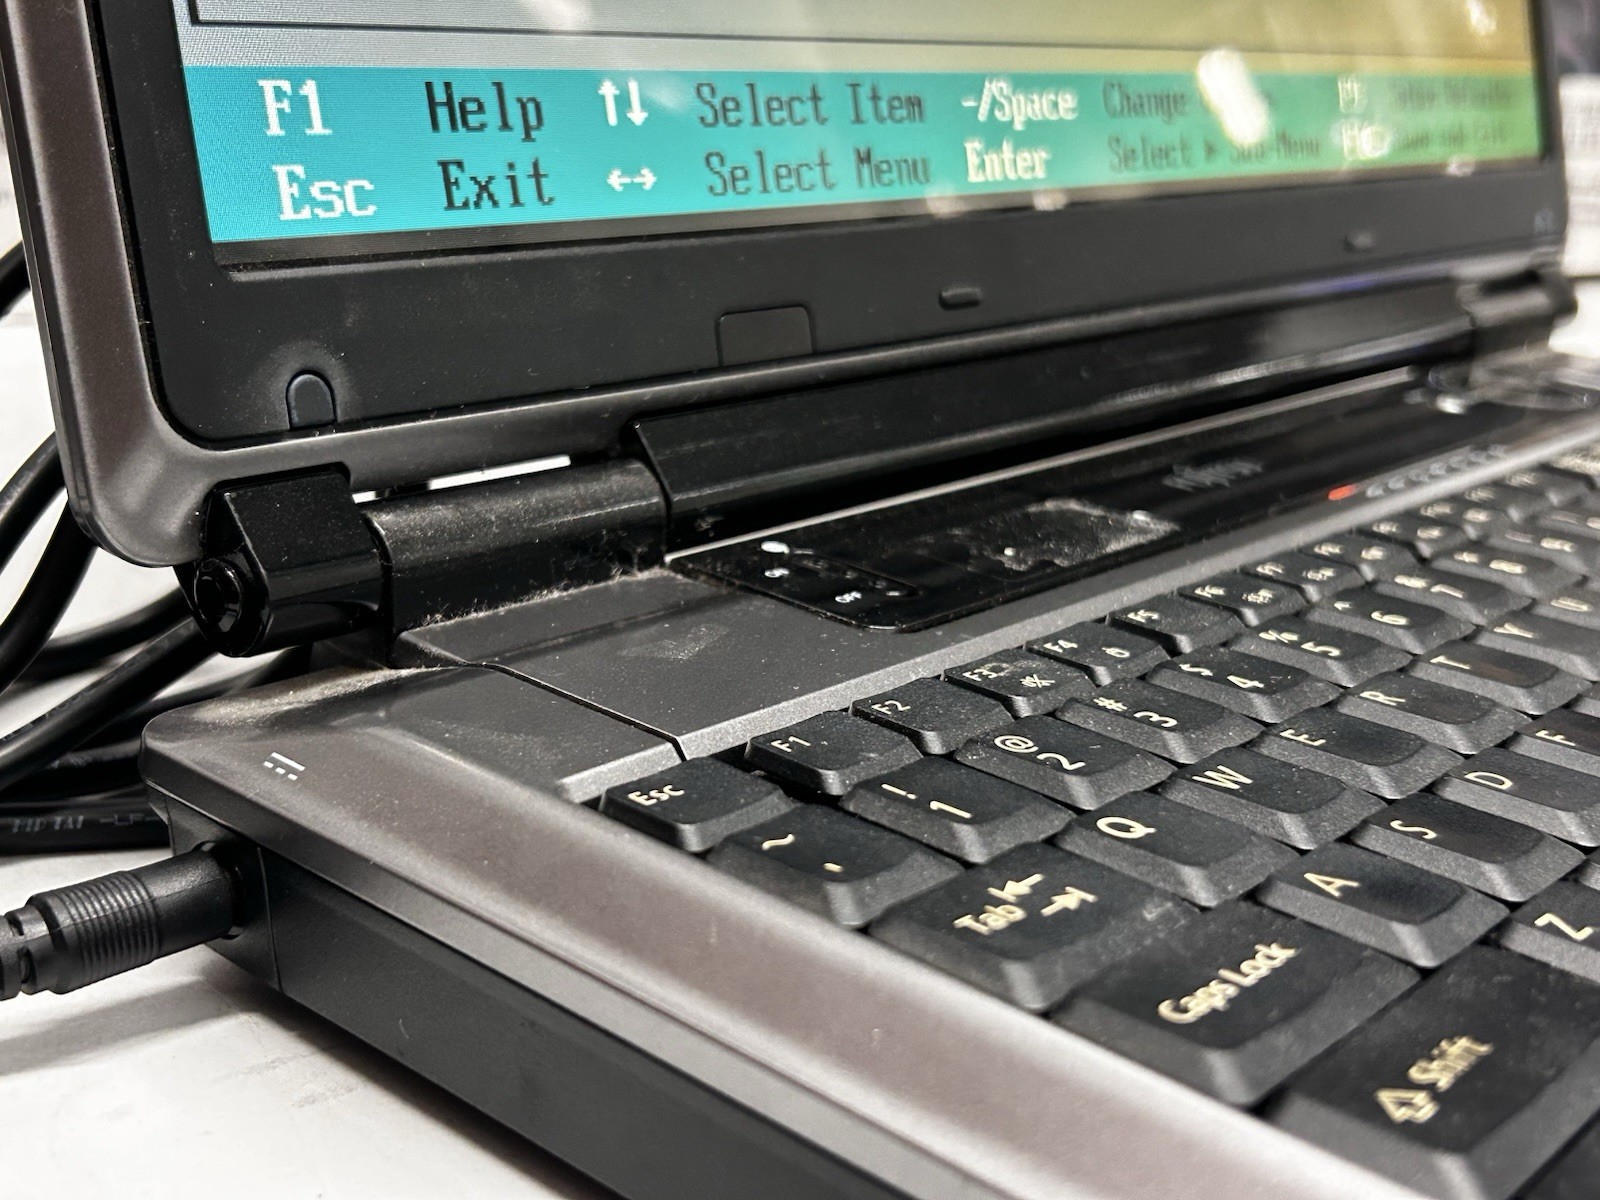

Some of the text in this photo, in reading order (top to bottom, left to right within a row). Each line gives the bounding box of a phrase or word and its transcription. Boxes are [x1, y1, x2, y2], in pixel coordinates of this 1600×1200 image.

[257, 78, 332, 136] F1
[424, 81, 544, 142] Help
[695, 82, 828, 128] Select
[846, 82, 924, 125] Item
[1103, 82, 1189, 126] Change
[272, 164, 376, 221] Esc
[437, 157, 555, 211] Exit
[704, 147, 836, 196] Select
[853, 145, 932, 188] Menu
[963, 138, 1050, 183] Enter
[1108, 134, 1193, 174] Select
[1127, 610, 1159, 624] F5
[1371, 610, 1410, 625] 6
[1494, 622, 1535, 640] Y
[1044, 639, 1078, 654] F4
[1301, 641, 1341, 657] 5
[1430, 655, 1471, 669] T
[962, 666, 998, 682] F3
[1227, 674, 1264, 691] 4
[871, 699, 911, 715] F2
[1359, 690, 1406, 706] R
[1133, 710, 1178, 728] 3
[771, 735, 811, 752] F1
[994, 734, 1039, 753] @
[1280, 728, 1326, 747] E
[1535, 730, 1576, 747] F
[1037, 752, 1086, 771] 2
[1192, 765, 1253, 791] W
[1464, 771, 1514, 790] D
[628, 784, 684, 807] Esc
[929, 800, 972, 819] 1
[1097, 816, 1156, 839] Q
[1390, 819, 1438, 840] S
[1303, 872, 1360, 897] A
[953, 904, 1027, 936] Tab
[1534, 912, 1594, 941] Z
[1157, 942, 1297, 1024] Caps Lock
[1408, 1036, 1494, 1092] Shift
